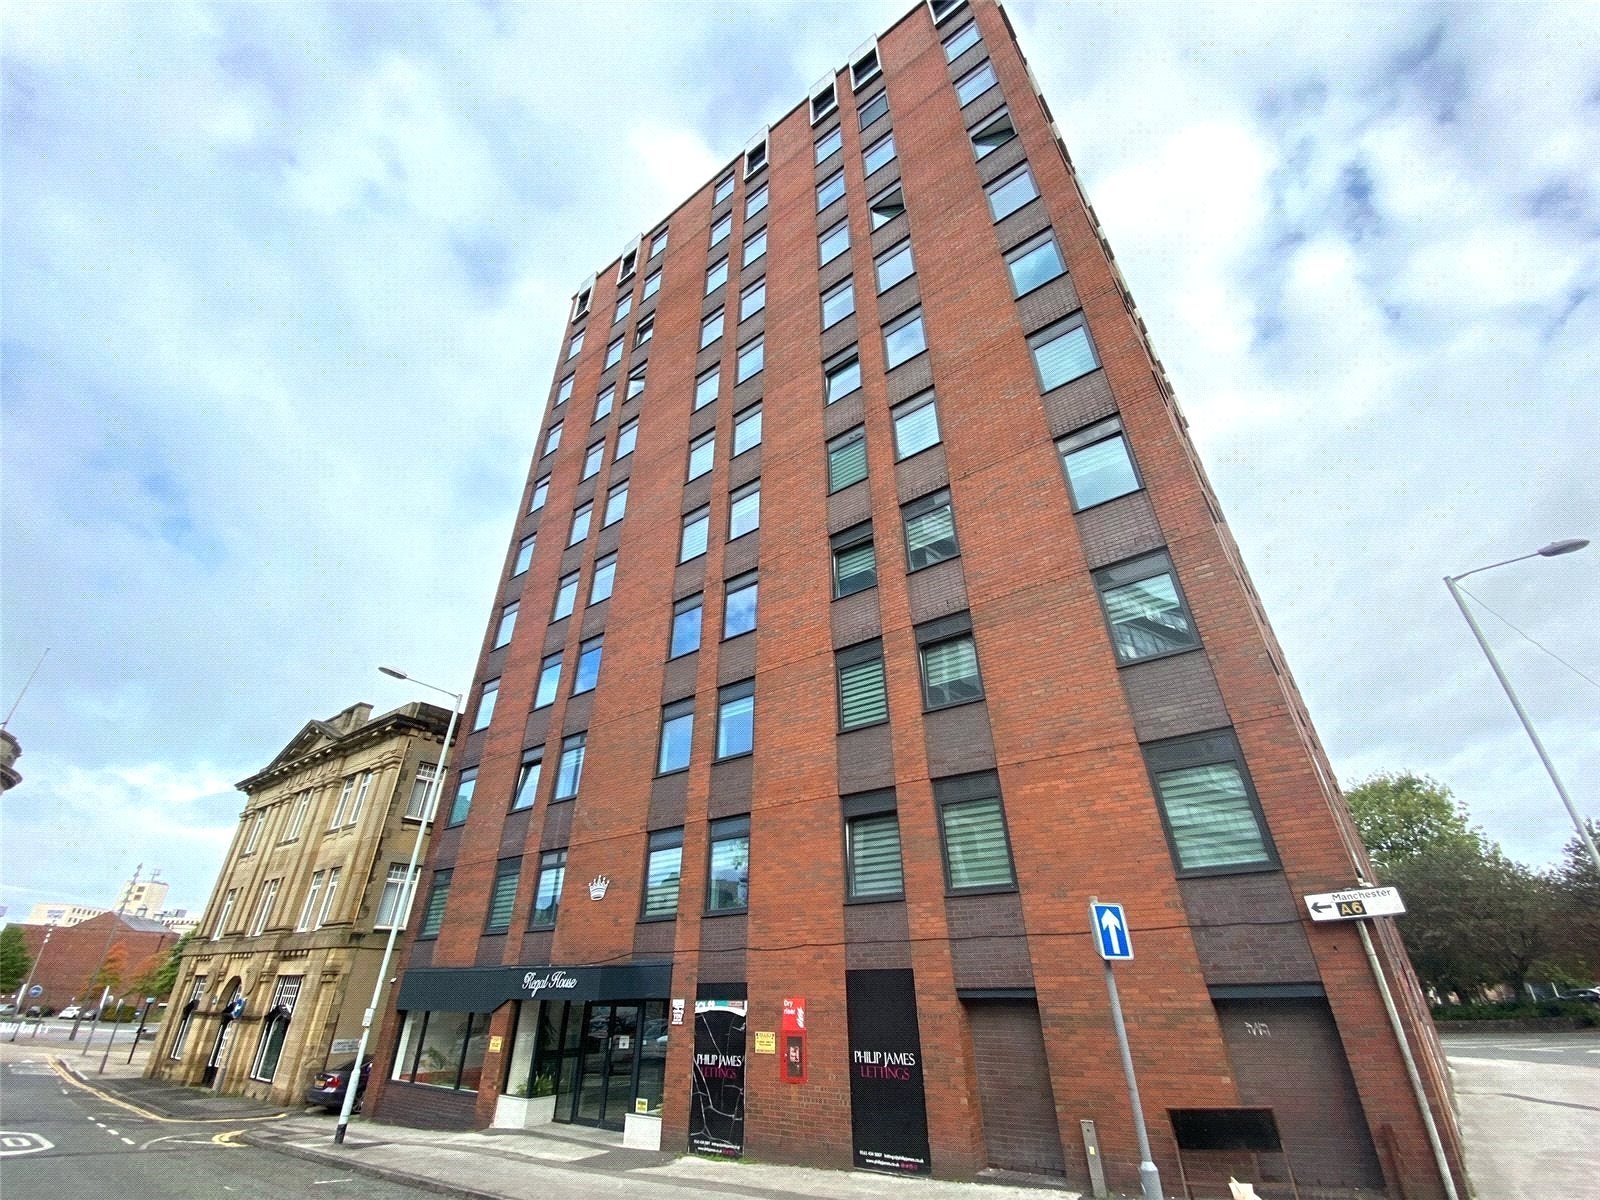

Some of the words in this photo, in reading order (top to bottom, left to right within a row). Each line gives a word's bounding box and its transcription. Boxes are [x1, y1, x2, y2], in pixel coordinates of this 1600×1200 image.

[1332, 884, 1391, 902] Manchester
[1341, 901, 1363, 915] A6
[522, 971, 550, 998] Regal
[548, 970, 578, 989] House
[783, 999, 794, 1008] Dry
[696, 1053, 718, 1065] PHILIP
[718, 1054, 742, 1069] JAMES
[854, 1050, 882, 1064] PHILIP
[883, 1051, 916, 1068] JAMES
[861, 1065, 910, 1080] LETTINGS
